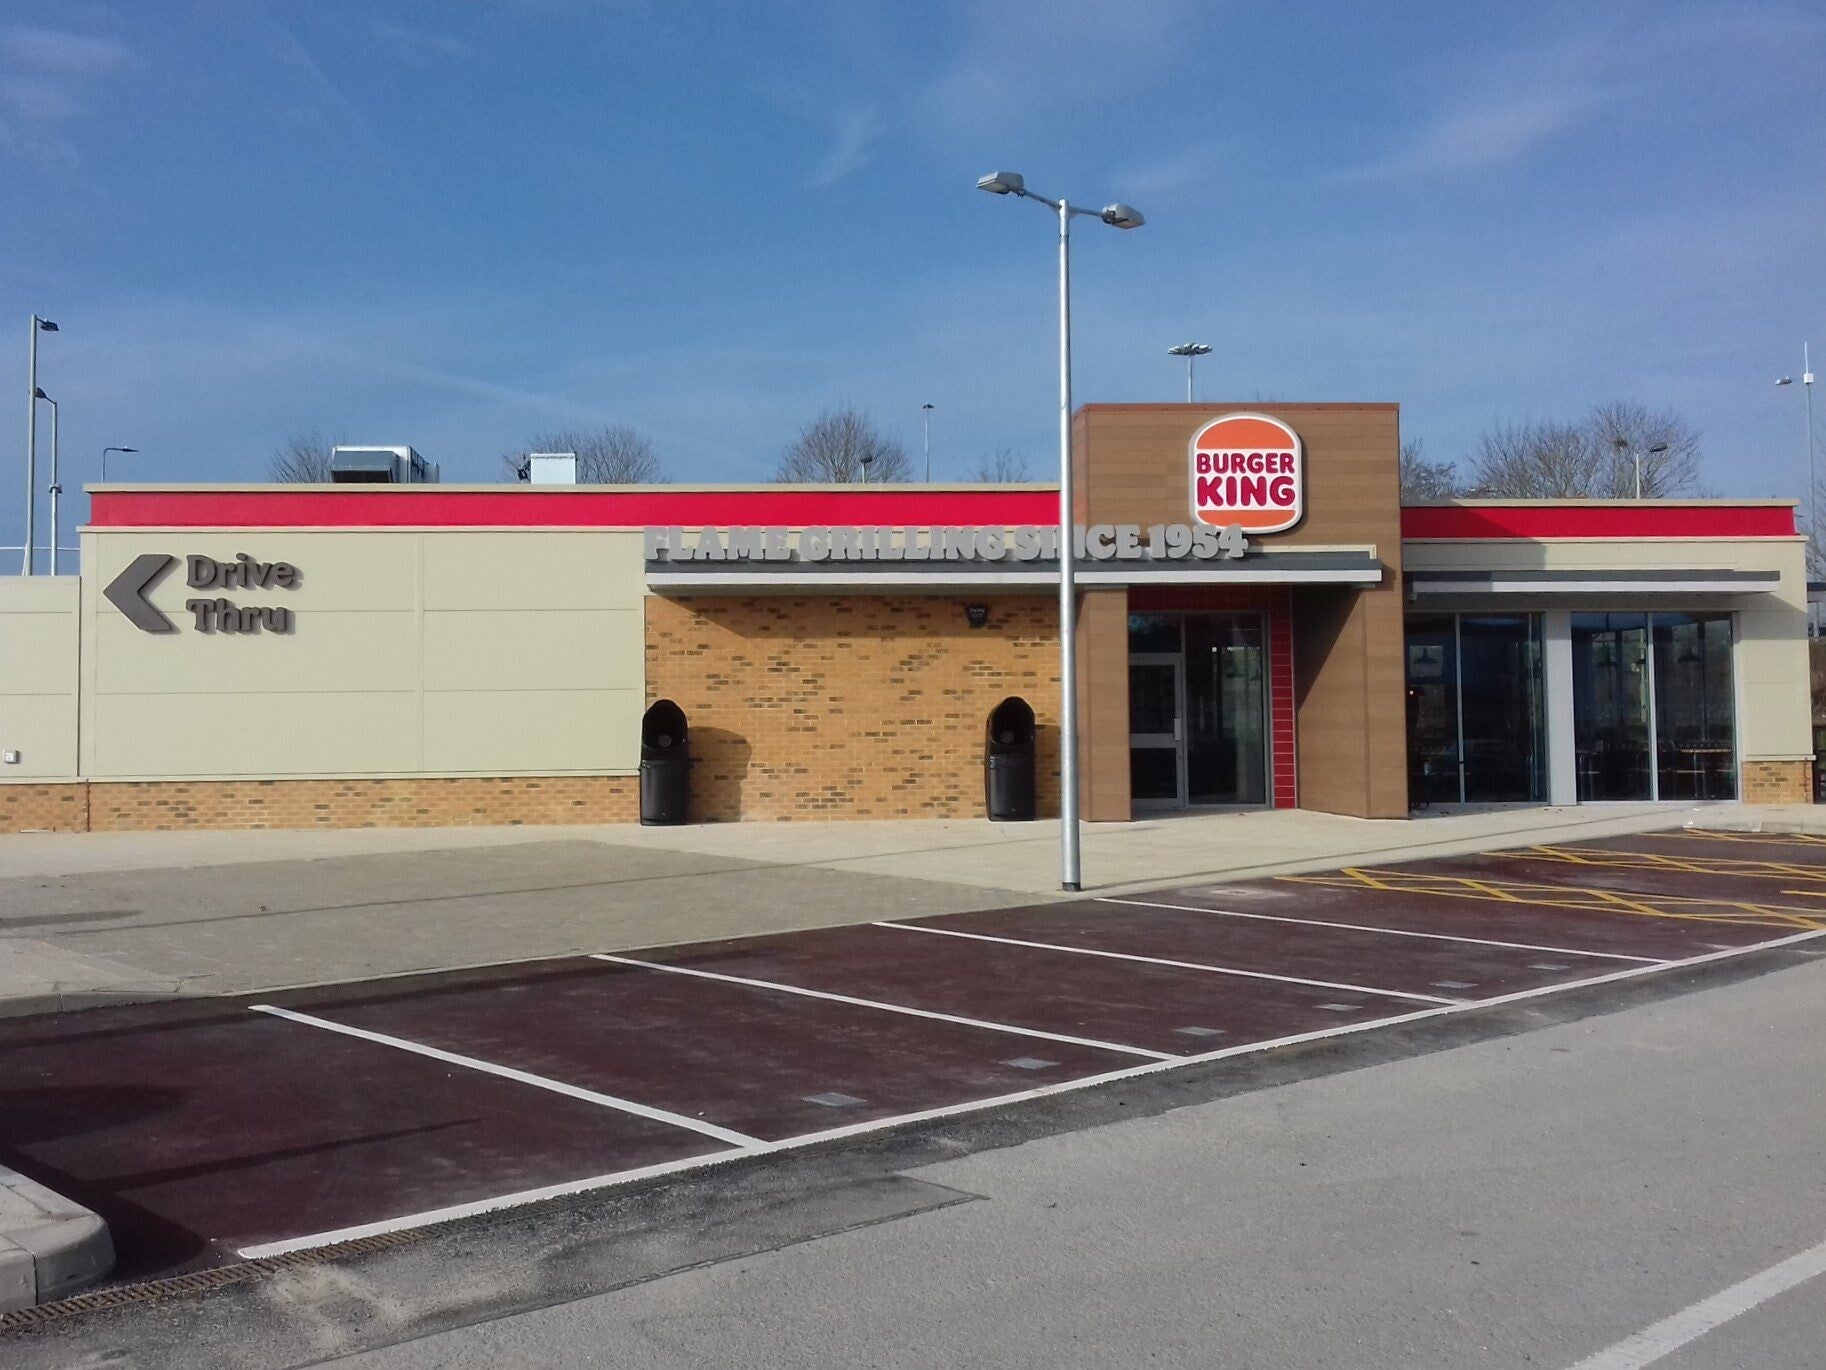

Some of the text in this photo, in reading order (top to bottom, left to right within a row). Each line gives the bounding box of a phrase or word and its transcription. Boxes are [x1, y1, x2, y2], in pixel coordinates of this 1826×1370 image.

[1197, 453, 1294, 474] BURGER
[1197, 476, 1295, 506] KING
[644, 525, 790, 560] FLAME
[799, 525, 1006, 560] GRILLING
[1149, 523, 1248, 558] 1954
[186, 553, 294, 587] Drive
[186, 598, 286, 631] Thru
